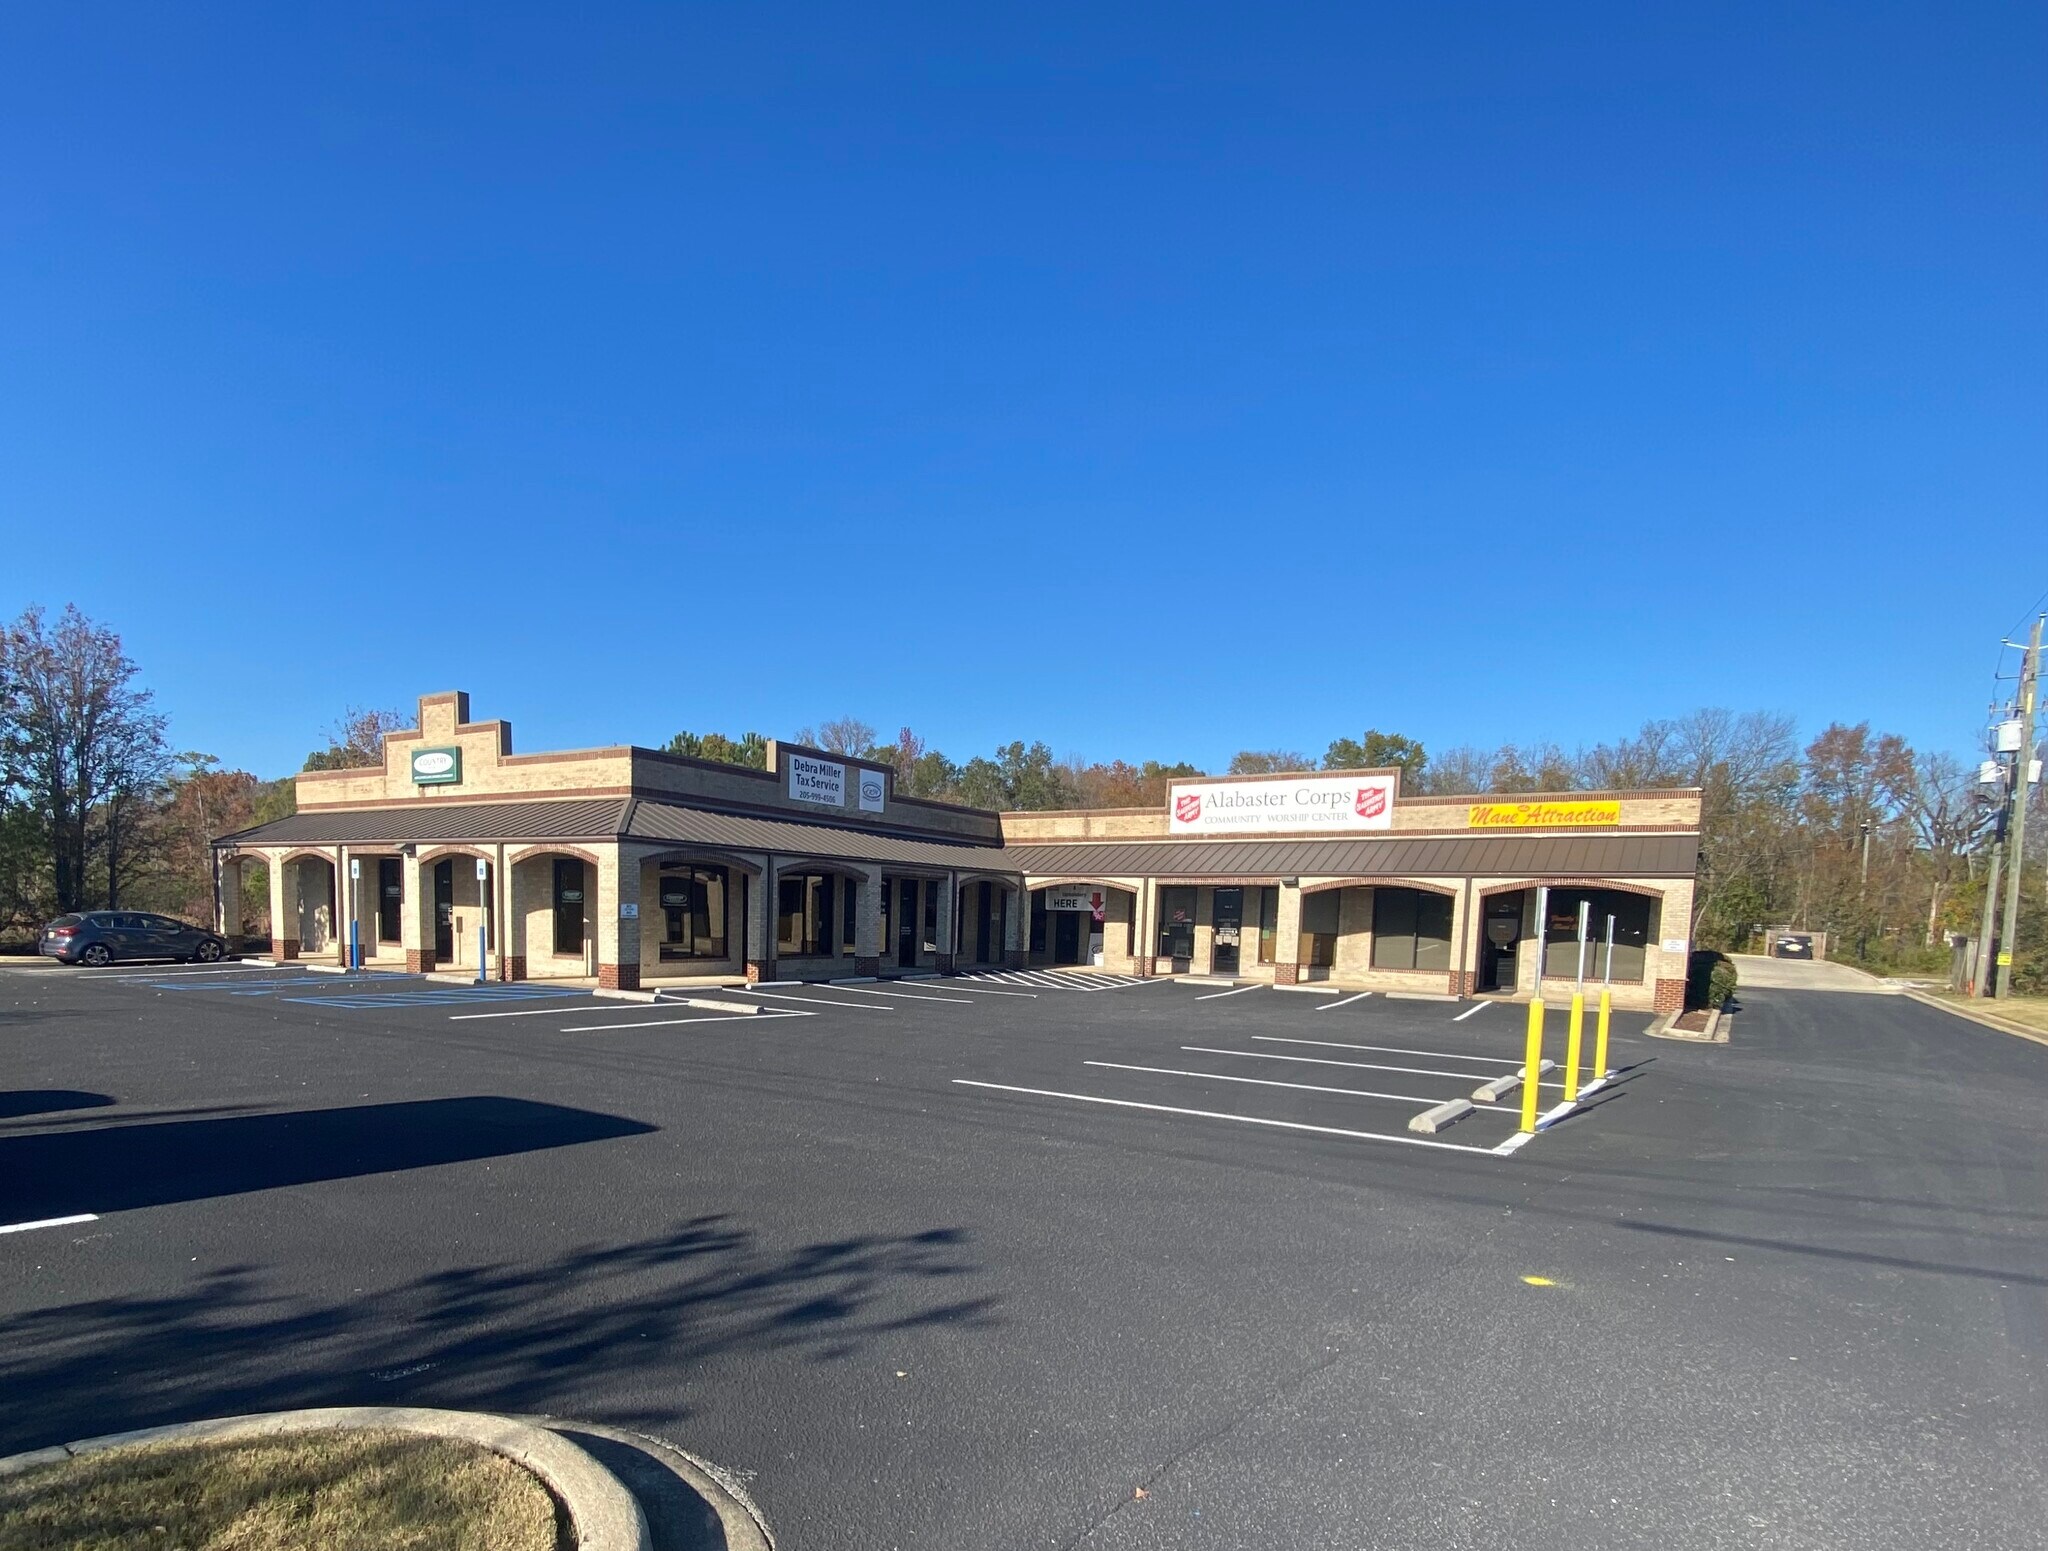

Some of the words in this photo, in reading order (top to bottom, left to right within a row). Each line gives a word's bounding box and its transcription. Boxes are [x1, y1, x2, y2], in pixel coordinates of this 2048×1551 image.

[794, 758, 818, 775] Debra
[819, 763, 842, 779] Miller
[795, 773, 810, 787] Tax
[810, 776, 840, 792] Service
[1205, 790, 1287, 809] Alabaster
[1294, 788, 1352, 809] Corps
[1204, 814, 1262, 825] COMMUNITY
[1267, 812, 1310, 823] WORSHIP
[1311, 812, 1349, 821] CENTER
[1471, 805, 1519, 825] Mane
[1523, 804, 1617, 825] Attraction
[1053, 898, 1078, 909] HERE
